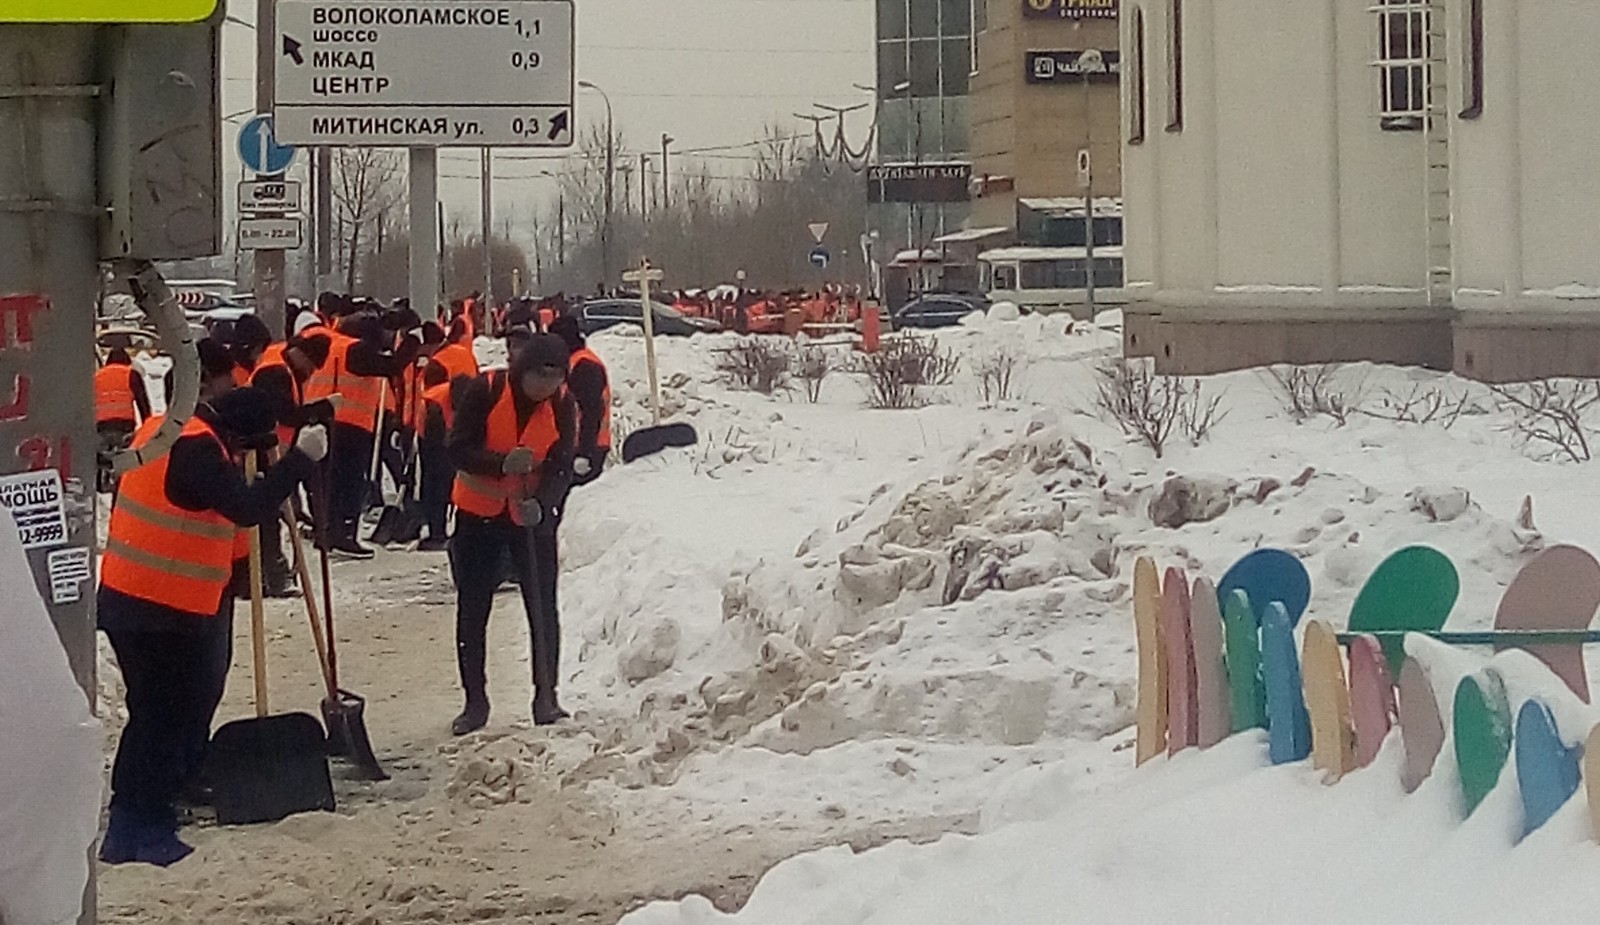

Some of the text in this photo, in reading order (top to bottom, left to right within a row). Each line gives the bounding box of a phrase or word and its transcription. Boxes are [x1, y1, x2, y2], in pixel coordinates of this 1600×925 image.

[312, 7, 510, 26] ВОЛОКОЛАМСКОЕ
[313, 28, 378, 43] шоссе
[513, 19, 541, 37] 1,1
[312, 51, 541, 71] МКАД 0,9
[312, 78, 389, 96] ЦЕНТР
[312, 118, 540, 138] МИТИНСКАЯ ул. 0,3
